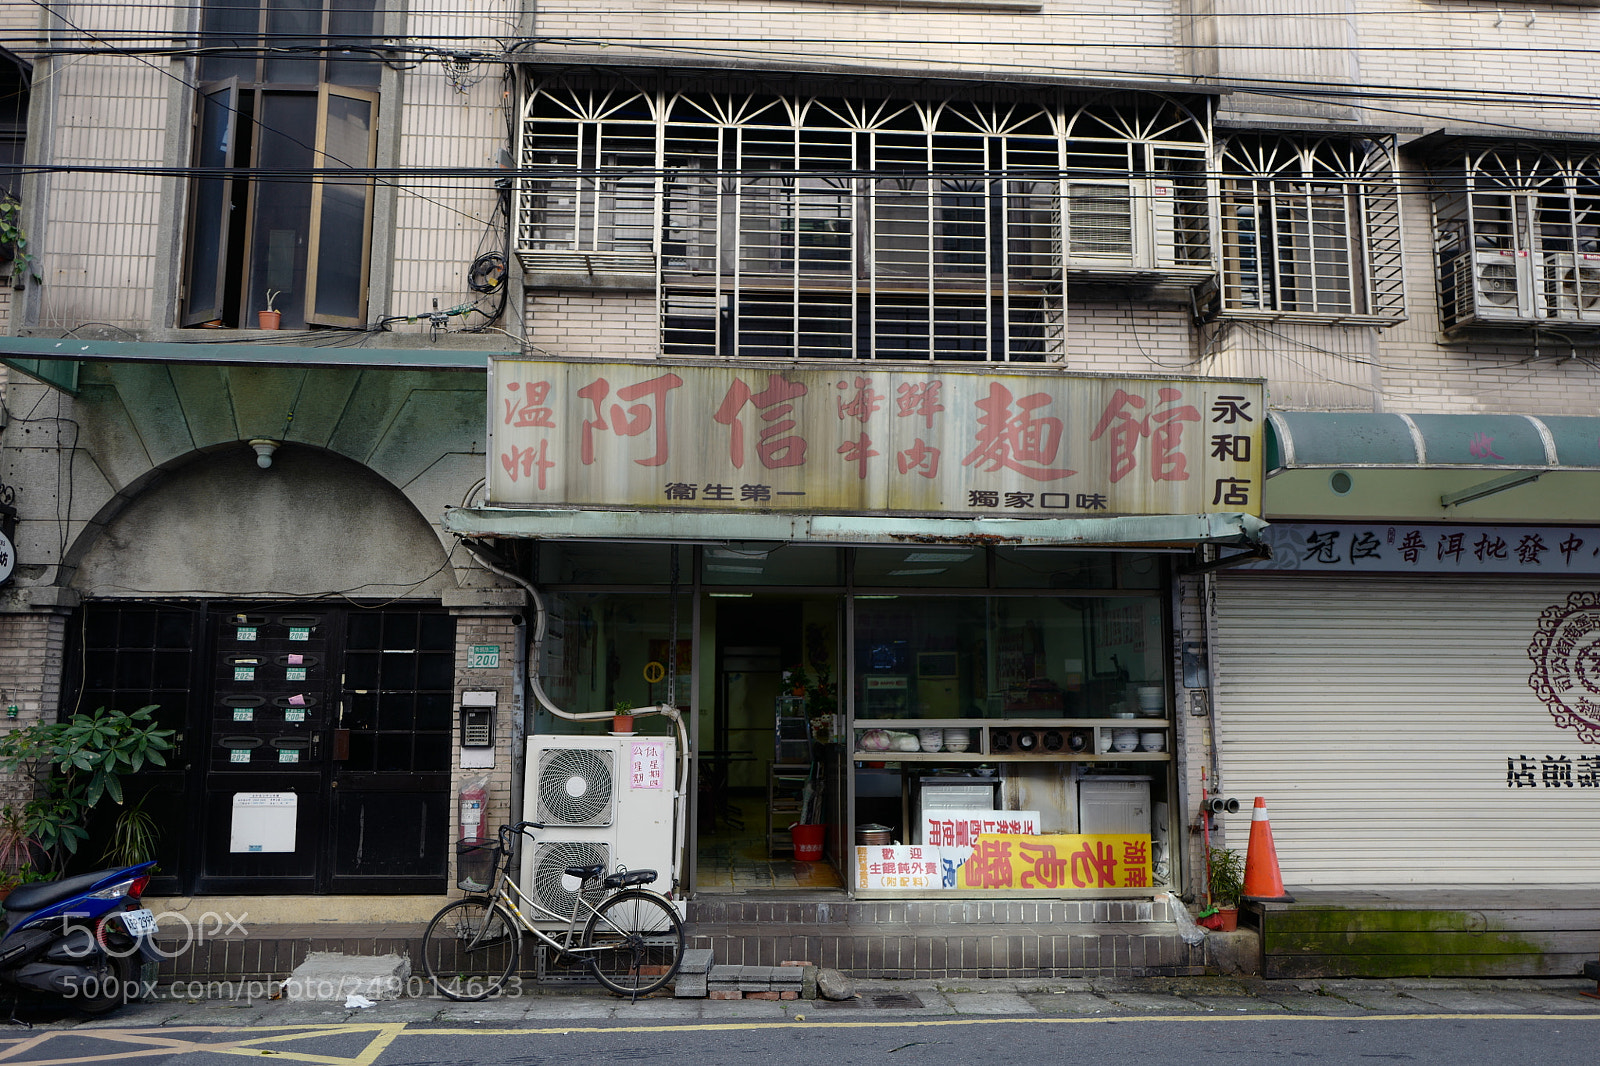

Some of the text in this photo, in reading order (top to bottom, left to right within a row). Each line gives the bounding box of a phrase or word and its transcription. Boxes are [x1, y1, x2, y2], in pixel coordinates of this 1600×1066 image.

[577, 372, 808, 470] 阿信
[837, 432, 942, 480] 牛肉
[1210, 394, 1254, 506] 永和店
[968, 489, 1108, 511] 獨家口味
[1397, 529, 1600, 567] 普洱批發中
[475, 655, 497, 666] 200
[881, 847, 923, 860] 歡迎
